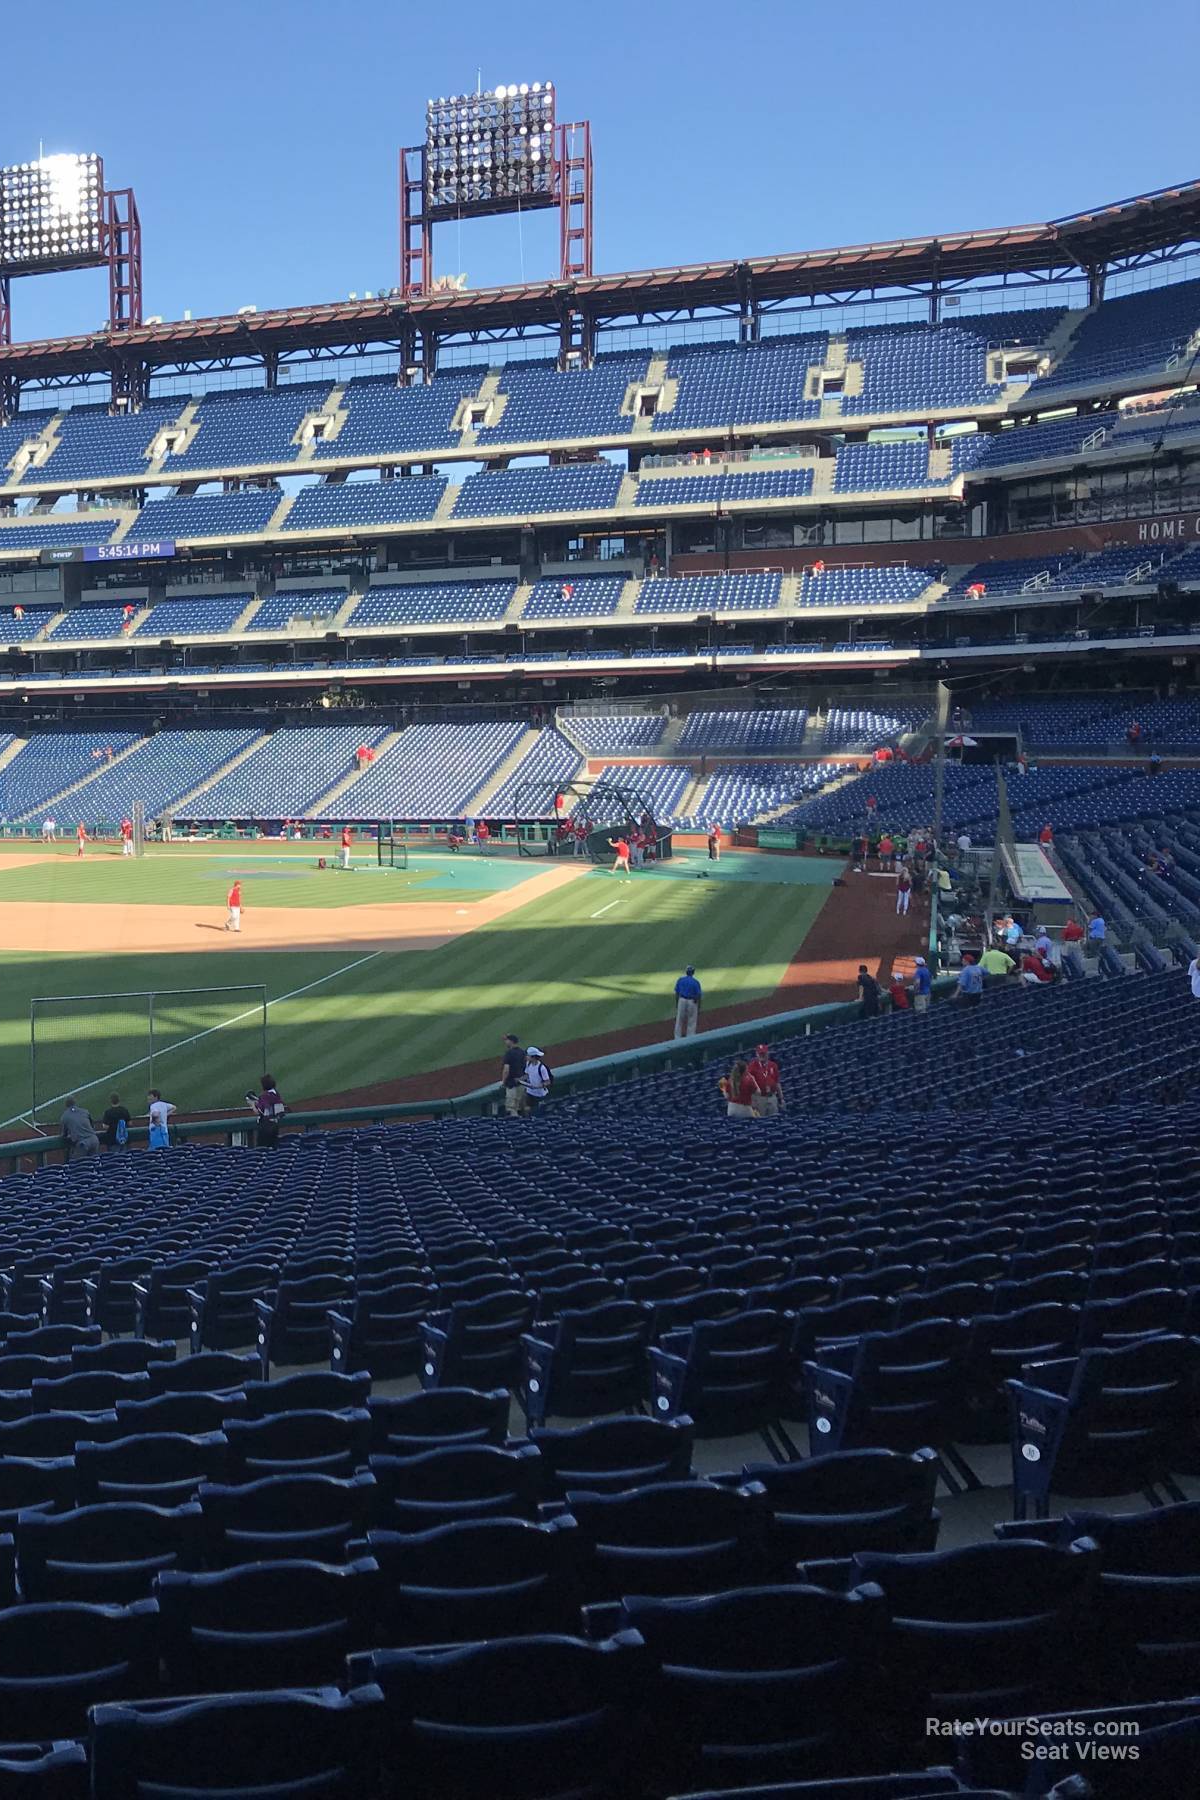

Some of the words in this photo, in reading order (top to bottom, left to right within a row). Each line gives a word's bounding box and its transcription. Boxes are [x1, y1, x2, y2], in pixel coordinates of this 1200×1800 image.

[1138, 519, 1185, 540] HOME
[98, 544, 138, 558] 5:45:14
[142, 543, 160, 555] PM
